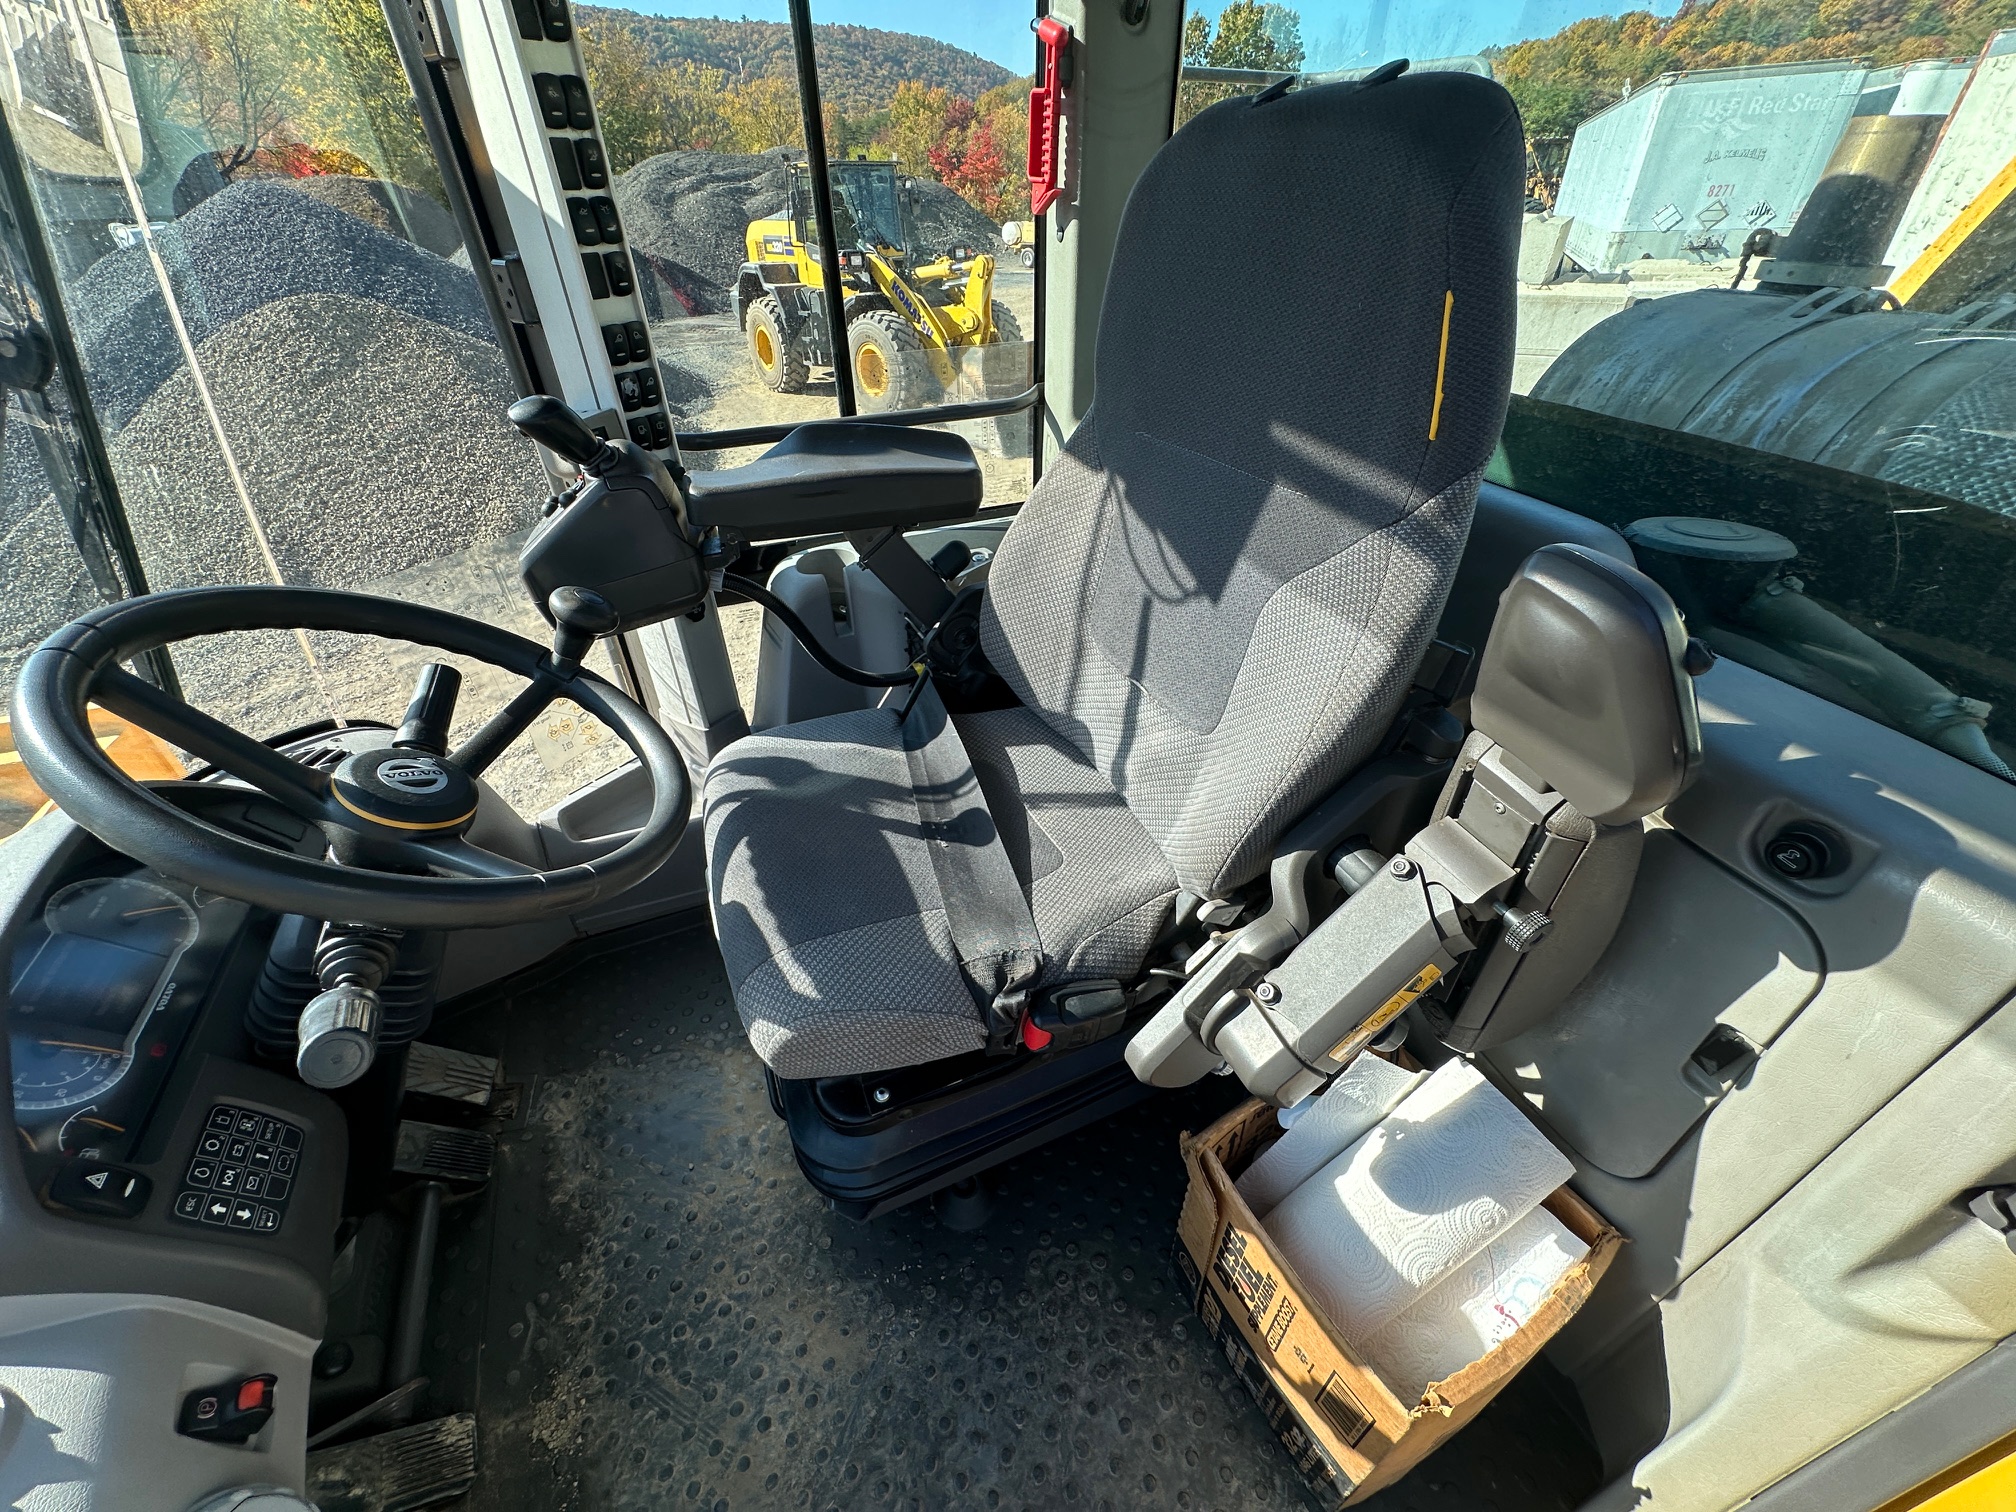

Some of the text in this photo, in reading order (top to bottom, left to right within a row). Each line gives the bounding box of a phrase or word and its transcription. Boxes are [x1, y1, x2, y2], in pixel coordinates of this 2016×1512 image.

[1748, 95, 1787, 115] Red
[1788, 92, 1831, 112] Star
[1706, 183, 1736, 198] 8271
[384, 769, 444, 779] VOLVO
[155, 982, 177, 1012] VOLVO
[264, 1122, 274, 1140] SETUP
[185, 1197, 198, 1212] ESC
[258, 1210, 268, 1227] SELECT
[1212, 1221, 1249, 1293] DIESEL
[1232, 1256, 1264, 1313] FUEL
[1279, 1299, 1297, 1327] BOOST
[1281, 1431, 1298, 1455] 32
